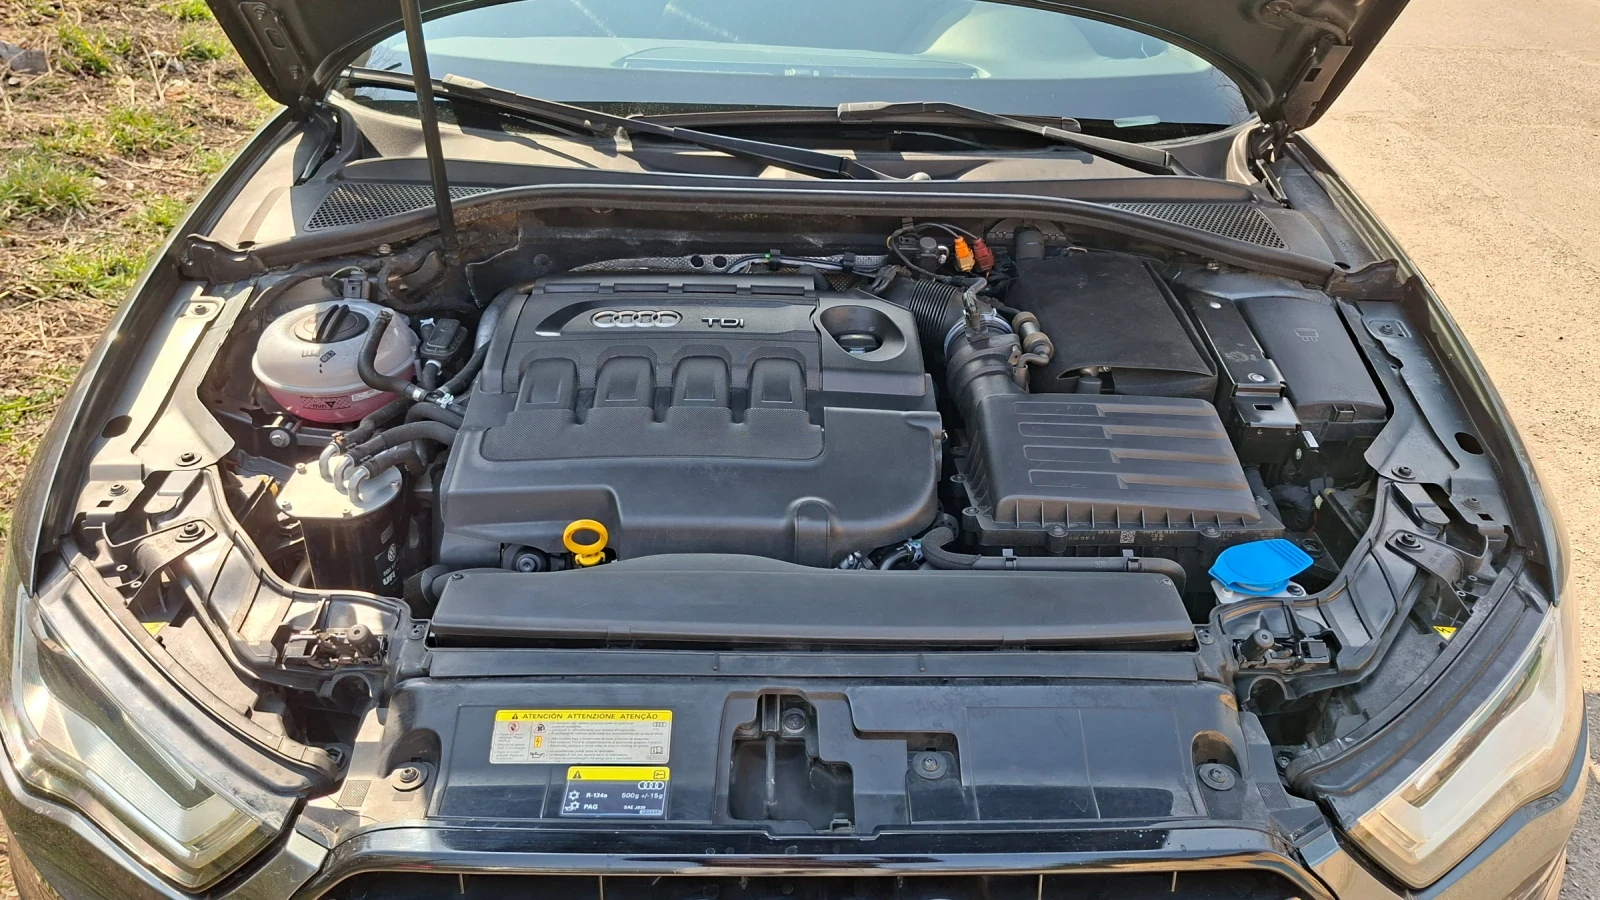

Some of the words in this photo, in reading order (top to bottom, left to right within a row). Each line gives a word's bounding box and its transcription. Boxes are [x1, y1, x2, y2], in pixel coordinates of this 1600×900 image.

[702, 317, 745, 328] TDI
[620, 712, 658, 720] ATENÇÃO
[621, 792, 639, 800] 500g
